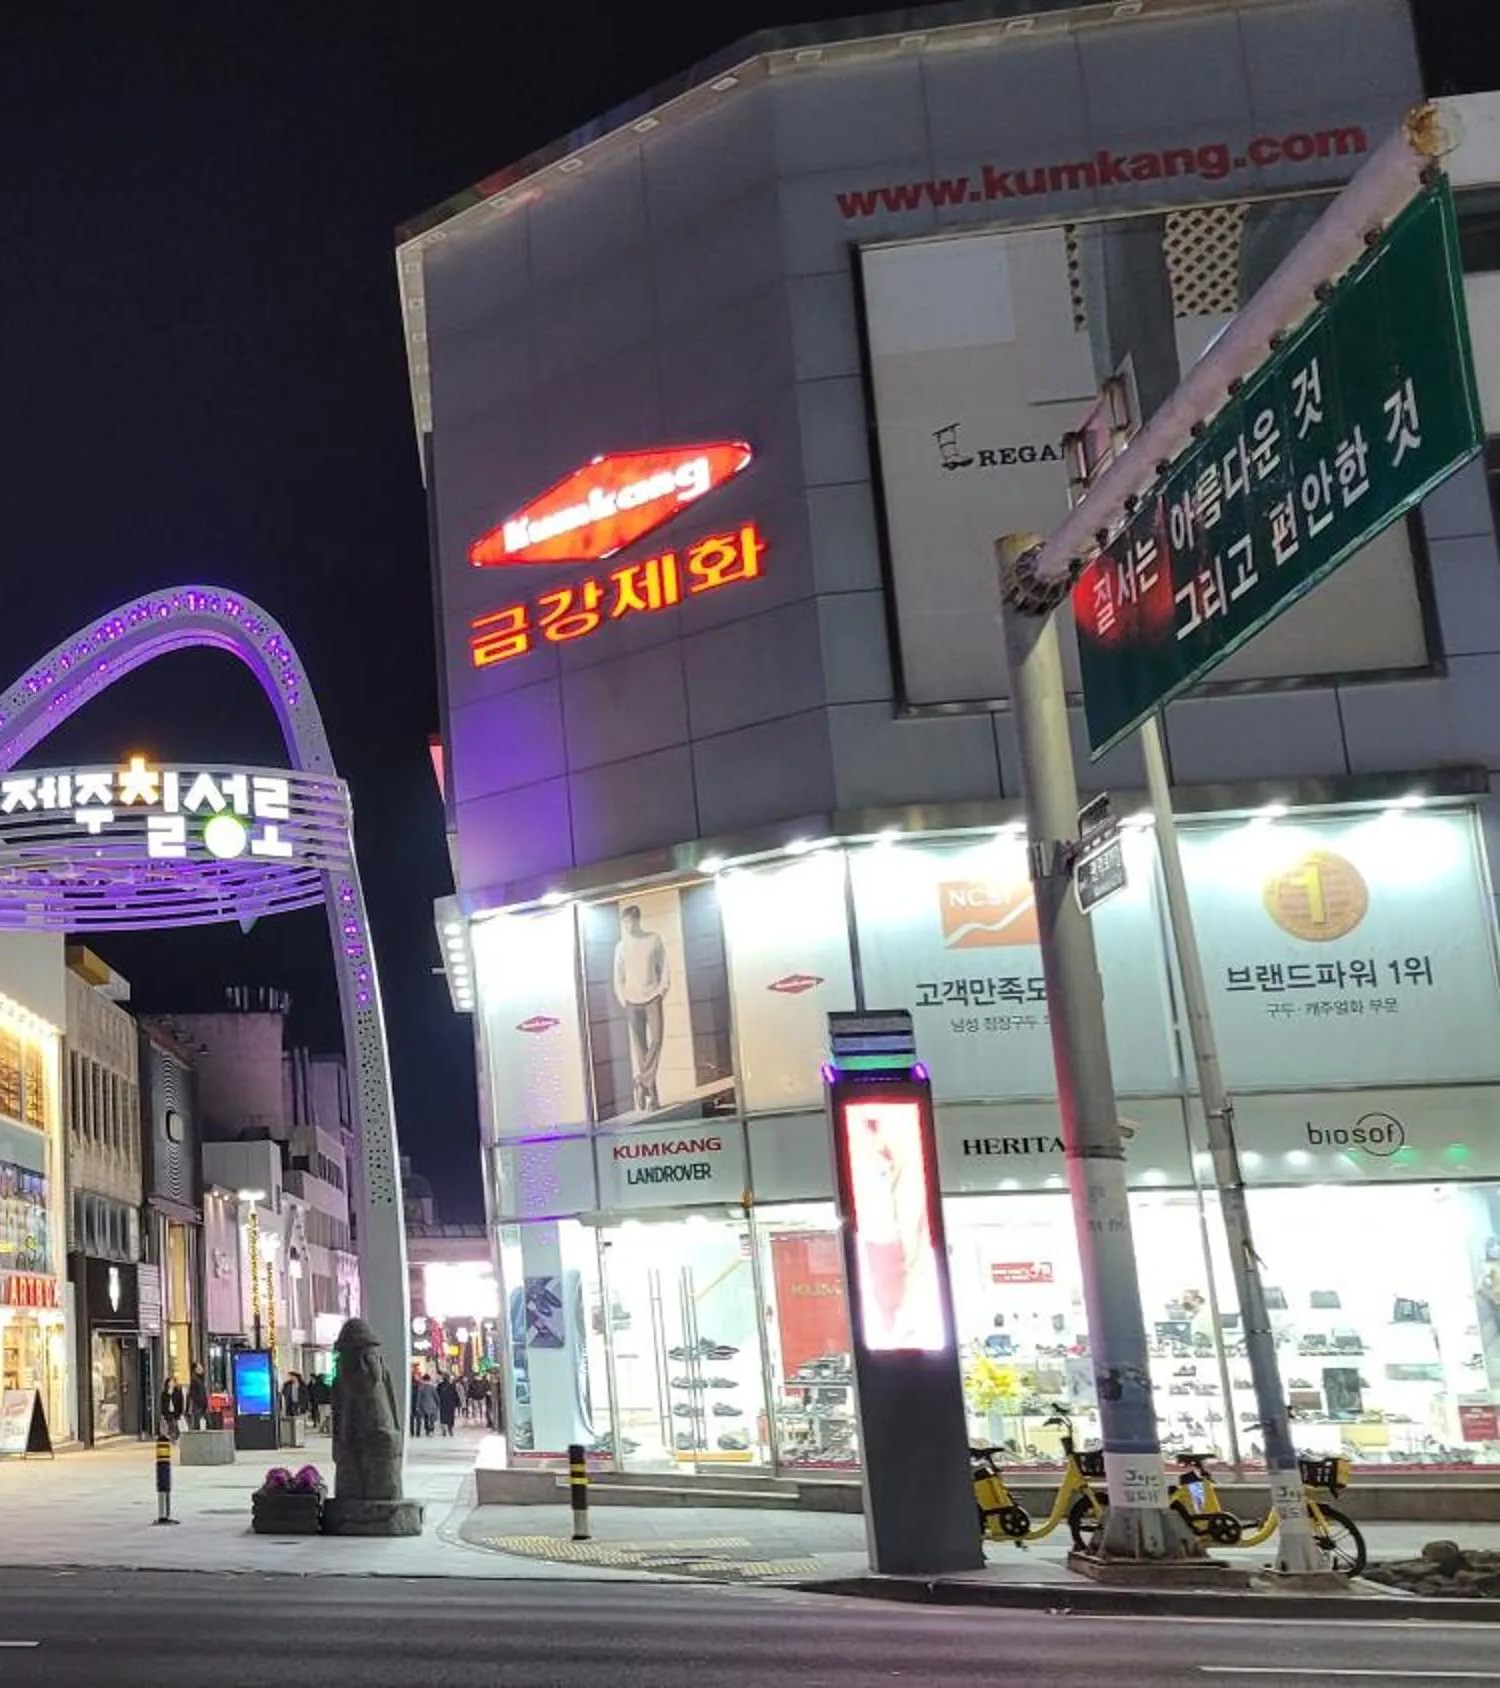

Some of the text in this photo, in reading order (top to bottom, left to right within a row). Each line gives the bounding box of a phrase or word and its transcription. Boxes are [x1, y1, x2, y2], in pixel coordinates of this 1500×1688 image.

[836, 121, 1367, 219] www.kumkang.com
[977, 443, 1066, 467] REGA
[1091, 356, 1324, 637] 질서는 아름다운 것
[1174, 376, 1422, 642] 그리고 편안한 것
[470, 521, 768, 668] 금강제화
[1225, 955, 1434, 992] 브랜드파워 1위
[1369, 996, 1399, 1014] 부문
[951, 1015, 980, 1033] 남성
[612, 1137, 723, 1161] KUMKANG
[962, 1135, 1067, 1156] HERITA
[626, 1162, 712, 1186] LANDROVER
